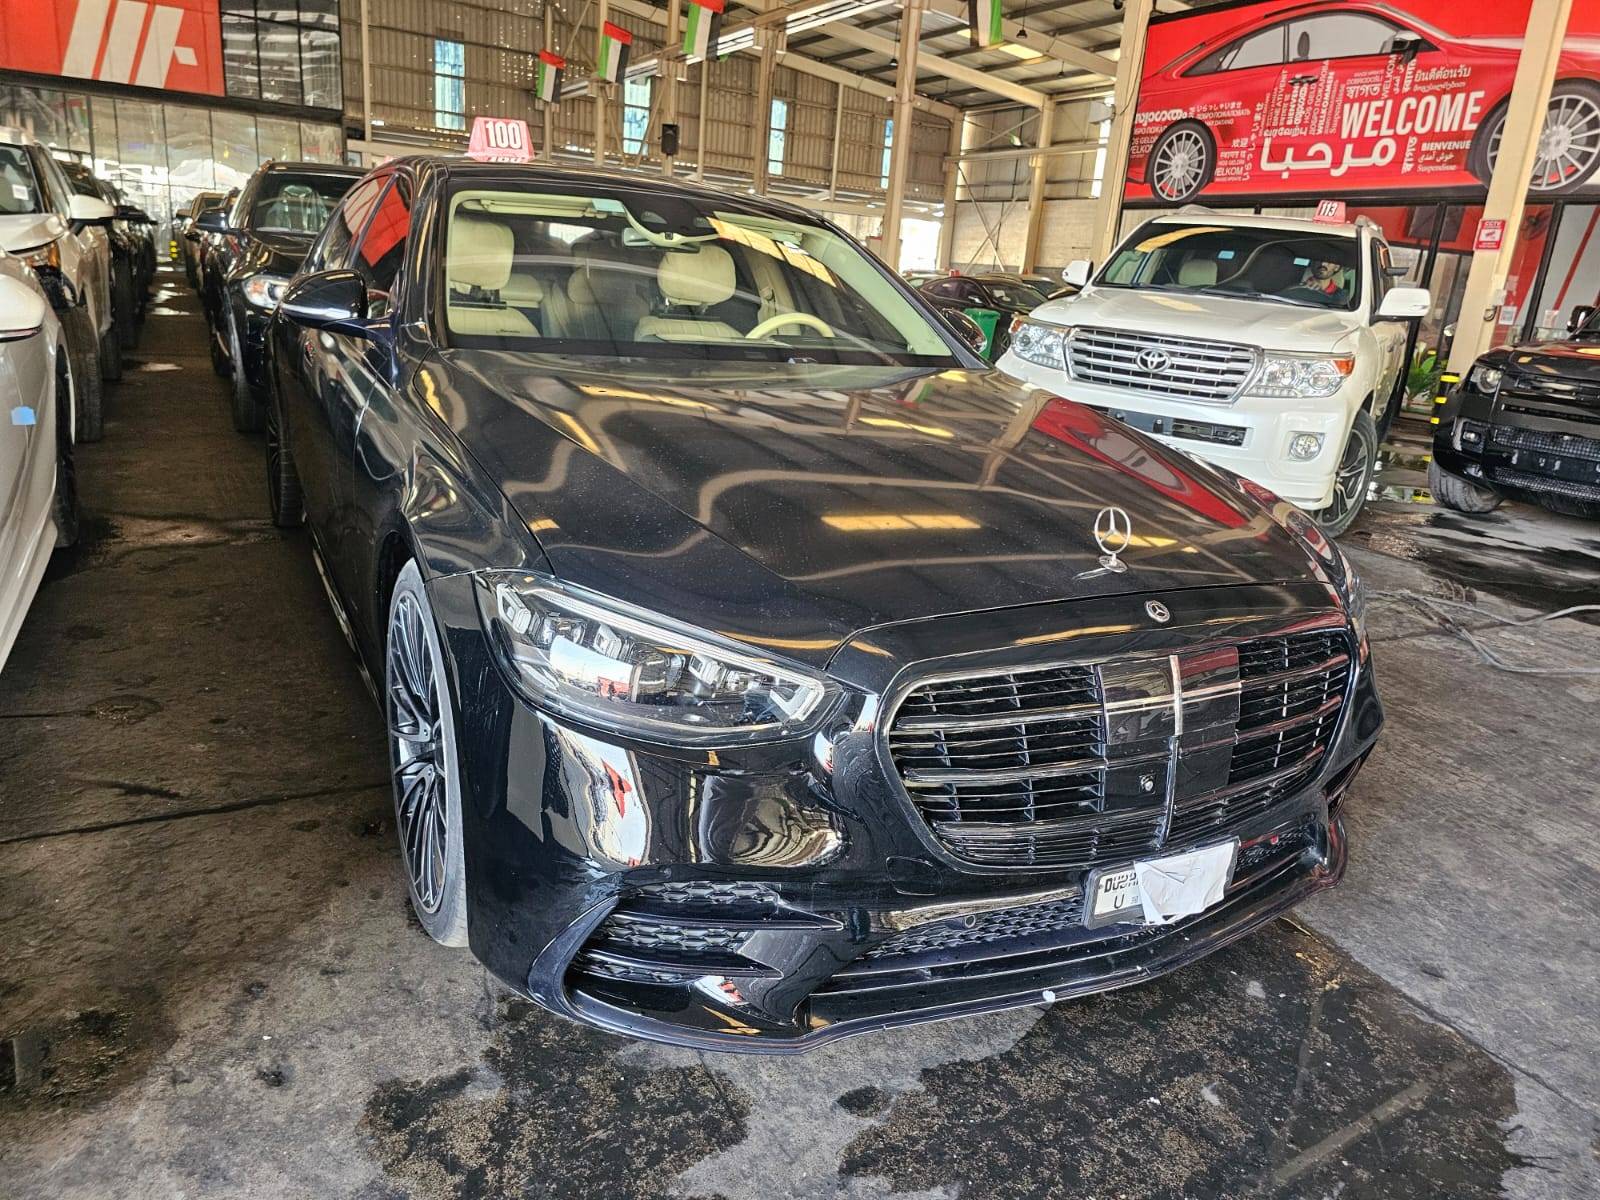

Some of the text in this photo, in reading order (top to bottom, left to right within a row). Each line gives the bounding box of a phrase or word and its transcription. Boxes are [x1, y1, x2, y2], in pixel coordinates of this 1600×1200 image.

[1317, 71, 1335, 135] WILLKOMMEN
[1341, 91, 1485, 139] WELCOME
[485, 120, 522, 149] 100
[1421, 140, 1471, 151] BIENVENUE
[1260, 137, 1397, 179] مرحبا
[1320, 201, 1338, 217] 113
[1114, 893, 1125, 909] U
